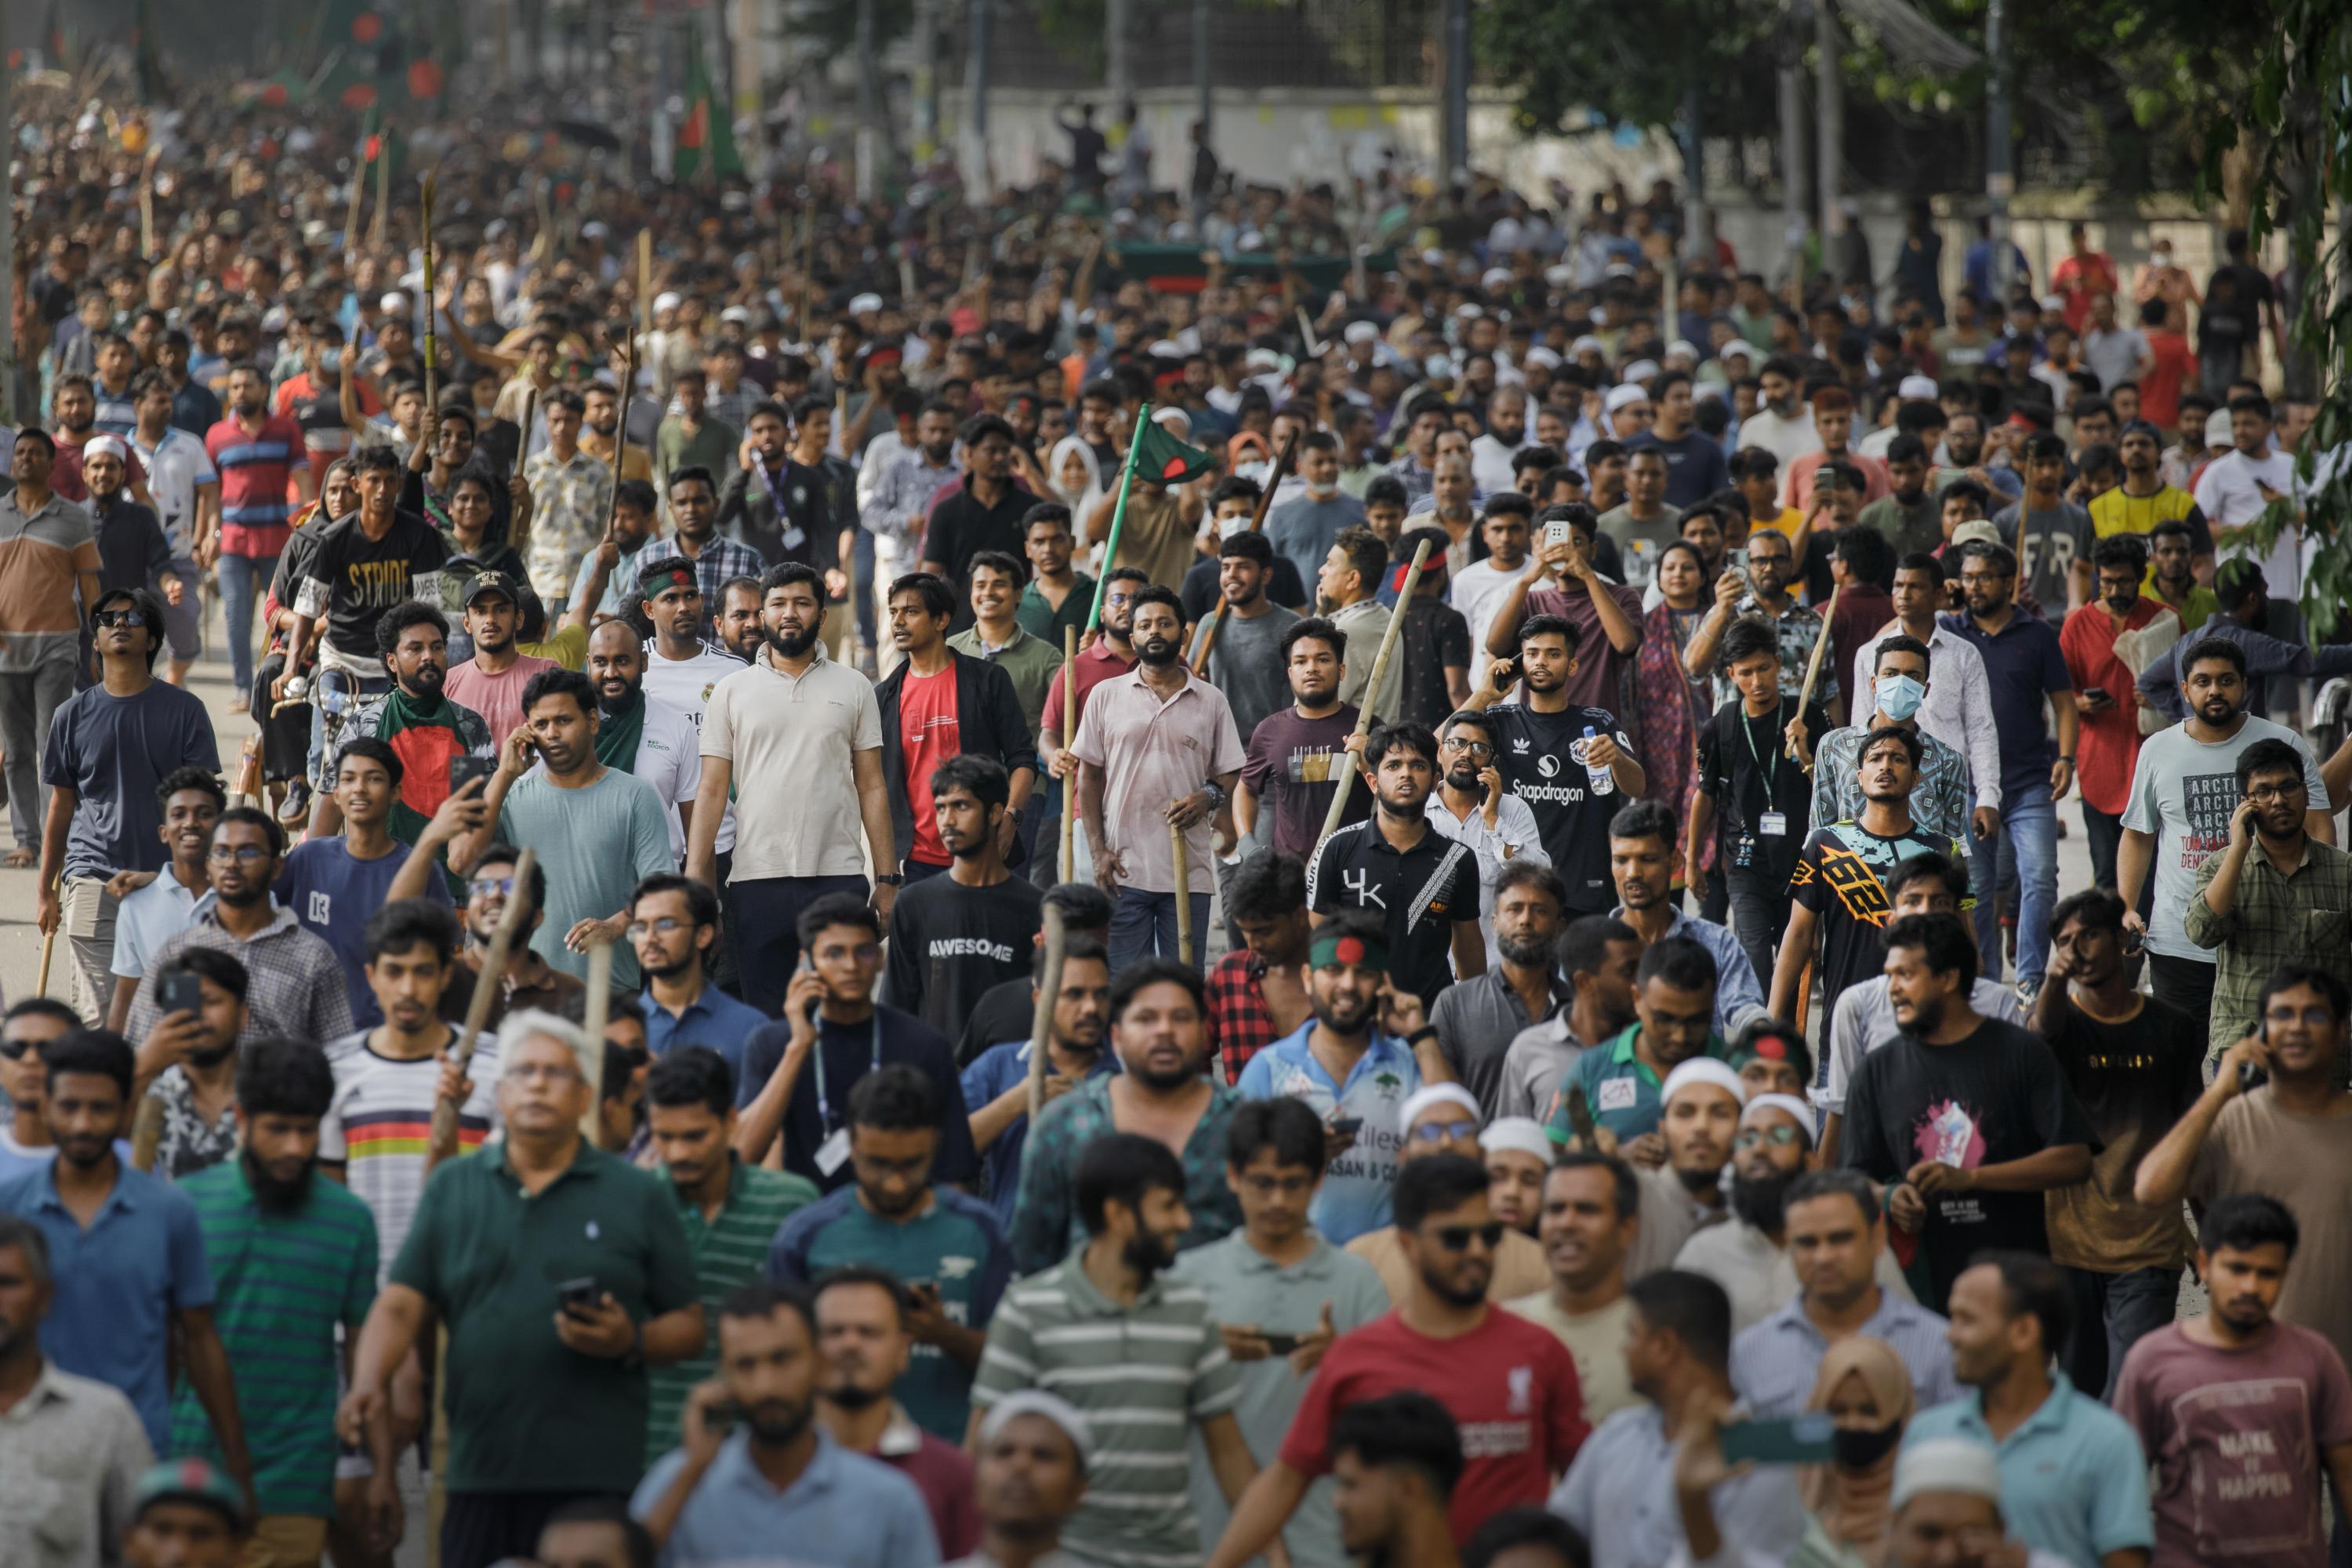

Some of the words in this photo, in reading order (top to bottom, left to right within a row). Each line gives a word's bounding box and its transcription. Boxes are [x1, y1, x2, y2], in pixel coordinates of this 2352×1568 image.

[348, 557, 409, 608] STRIDE
[1512, 779, 1584, 806] Snapdragon
[2191, 777, 2237, 794] ARCTI
[2193, 794, 2238, 811] ARCTI
[2195, 811, 2231, 828] ARCT
[1306, 866, 1316, 895] NUR
[308, 891, 330, 925] 03
[929, 938, 1014, 963] AWESOME
